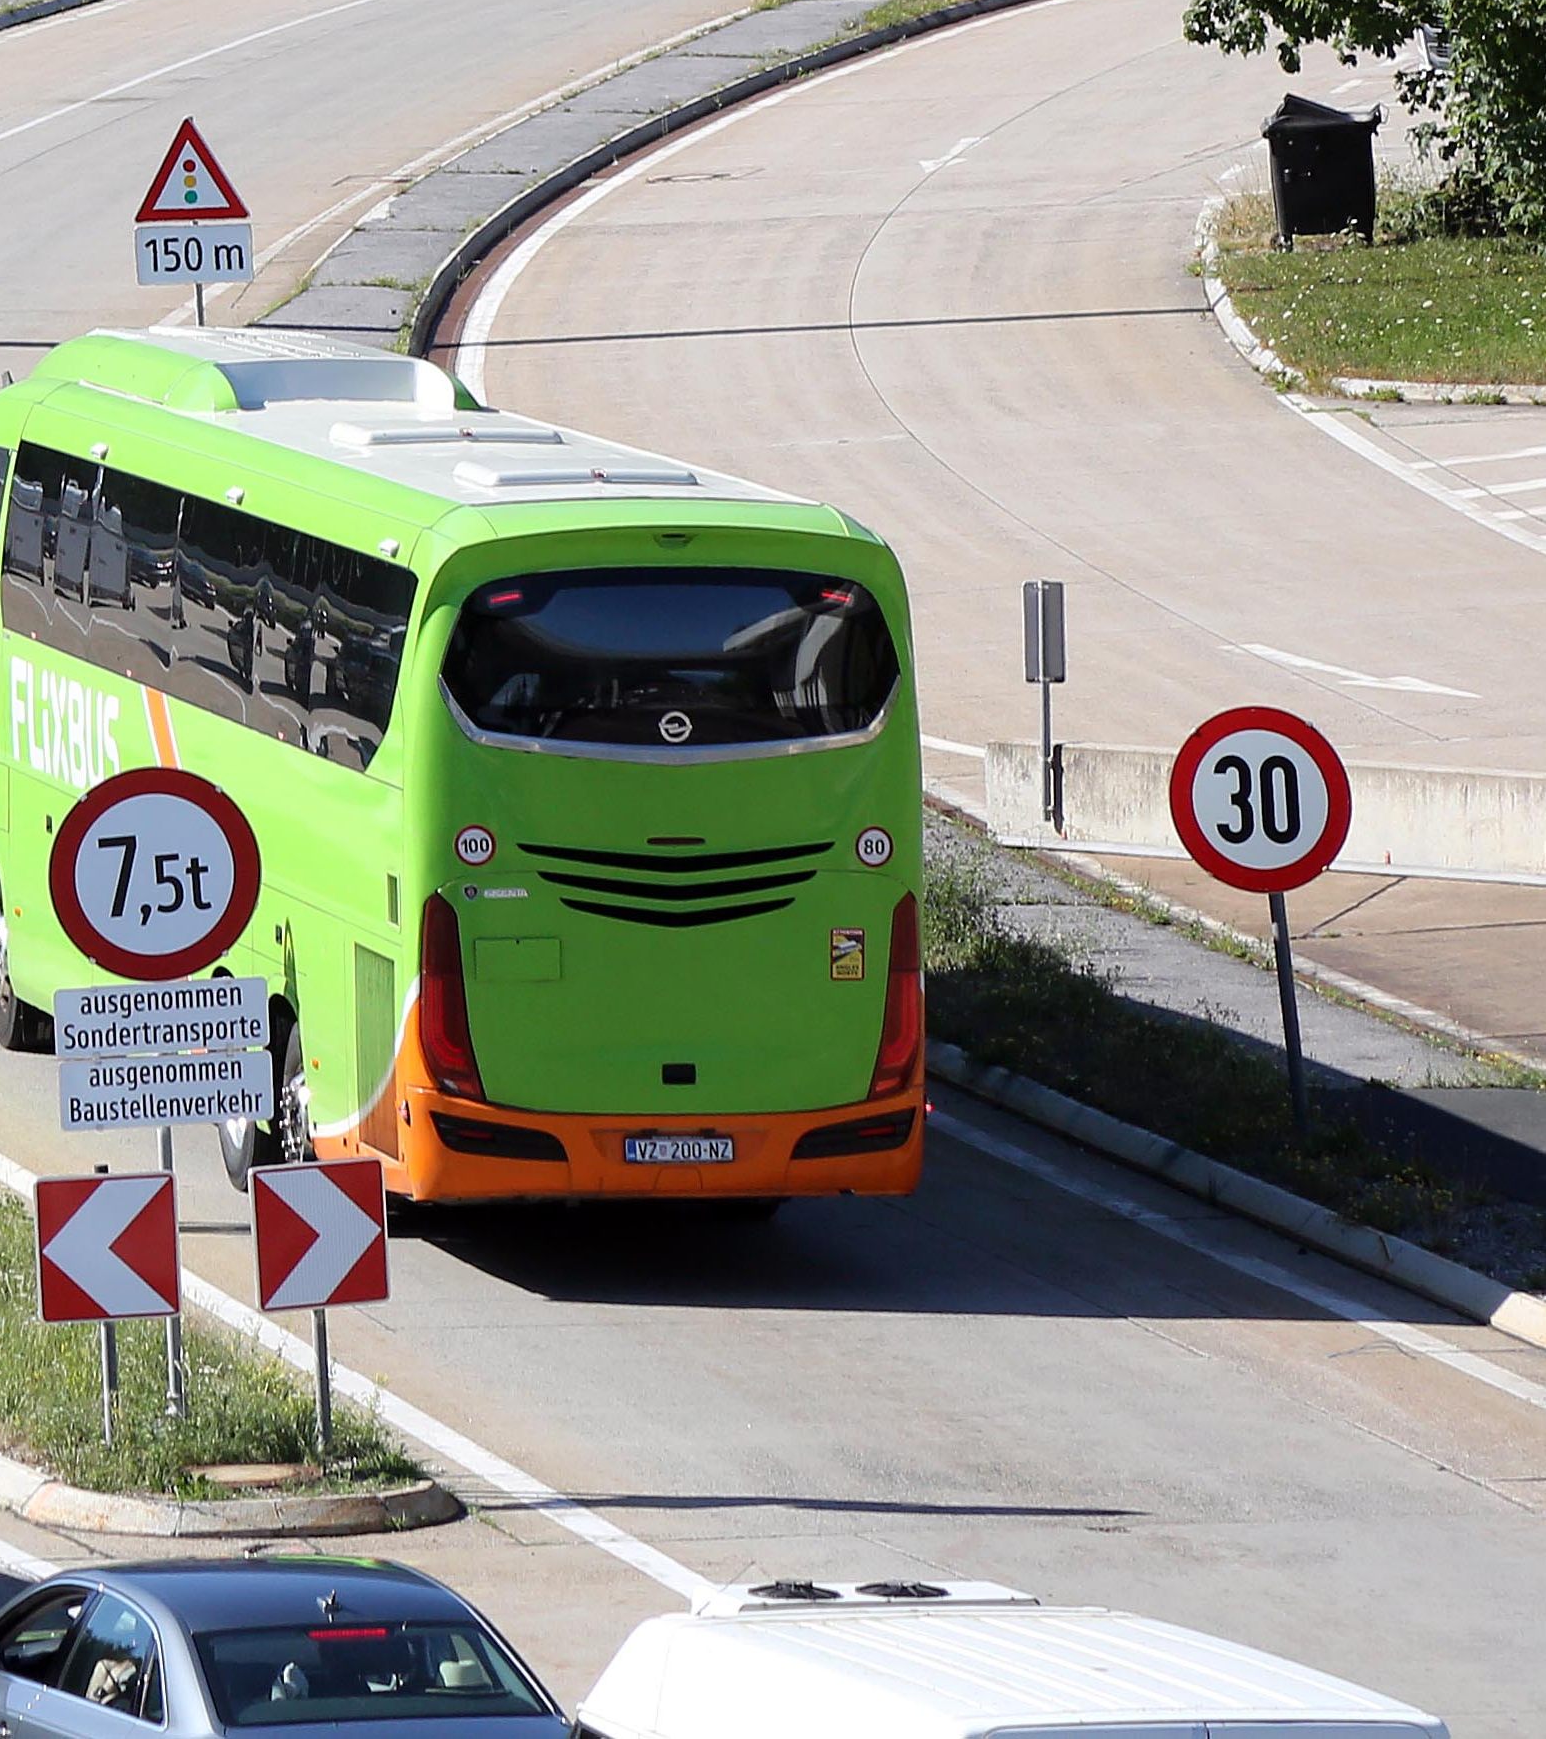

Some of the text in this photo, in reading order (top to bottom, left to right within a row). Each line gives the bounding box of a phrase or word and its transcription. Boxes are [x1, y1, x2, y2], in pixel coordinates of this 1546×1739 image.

[144, 236, 245, 273] 150 m
[1212, 754, 1302, 846] 30
[461, 837, 491, 854] 100
[863, 839, 886, 855] 80
[79, 983, 244, 1018] ausgenommen
[62, 1012, 263, 1052] Sondertransporte
[88, 1056, 244, 1089] ausgenommen
[68, 1088, 264, 1124] Baustellenverkehr
[637, 1141, 658, 1160] VZ
